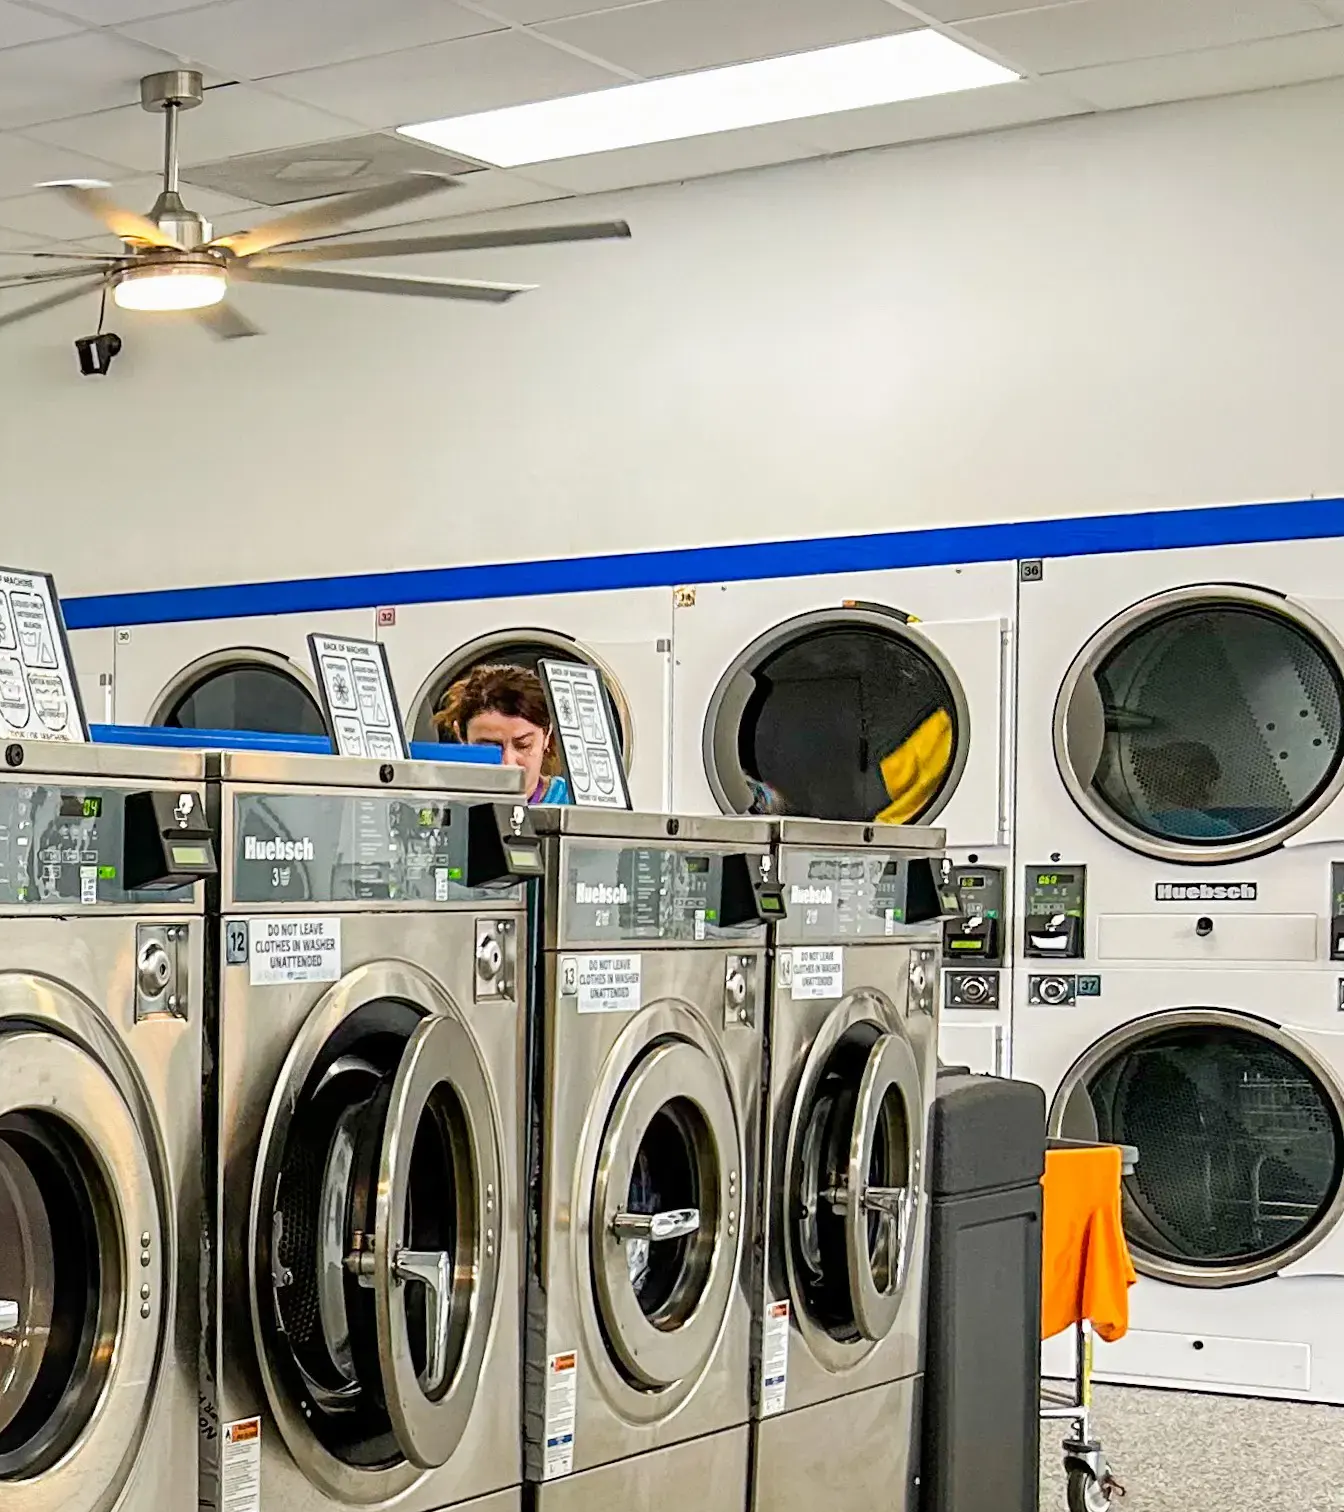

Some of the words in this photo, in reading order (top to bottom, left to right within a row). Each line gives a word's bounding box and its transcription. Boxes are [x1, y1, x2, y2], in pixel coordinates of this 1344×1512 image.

[1024, 566, 1039, 576] 36
[381, 613, 392, 622] 32
[119, 632, 129, 641] 30
[244, 836, 313, 861] Huebsch
[272, 867, 279, 886] 3
[1157, 885, 1256, 899] Huebsch
[268, 924, 279, 936] DO
[281, 924, 297, 936] NOT
[300, 923, 323, 935] LEAVE
[231, 932, 244, 951] 12
[255, 940, 291, 953] CLOTHES
[293, 939, 301, 951] IN
[303, 938, 335, 951] WASHER
[270, 956, 322, 968] UNATTENDED
[589, 960, 598, 970] DO
[599, 960, 612, 970] NOT
[564, 968, 574, 984] 13
[1082, 980, 1095, 990] 37
